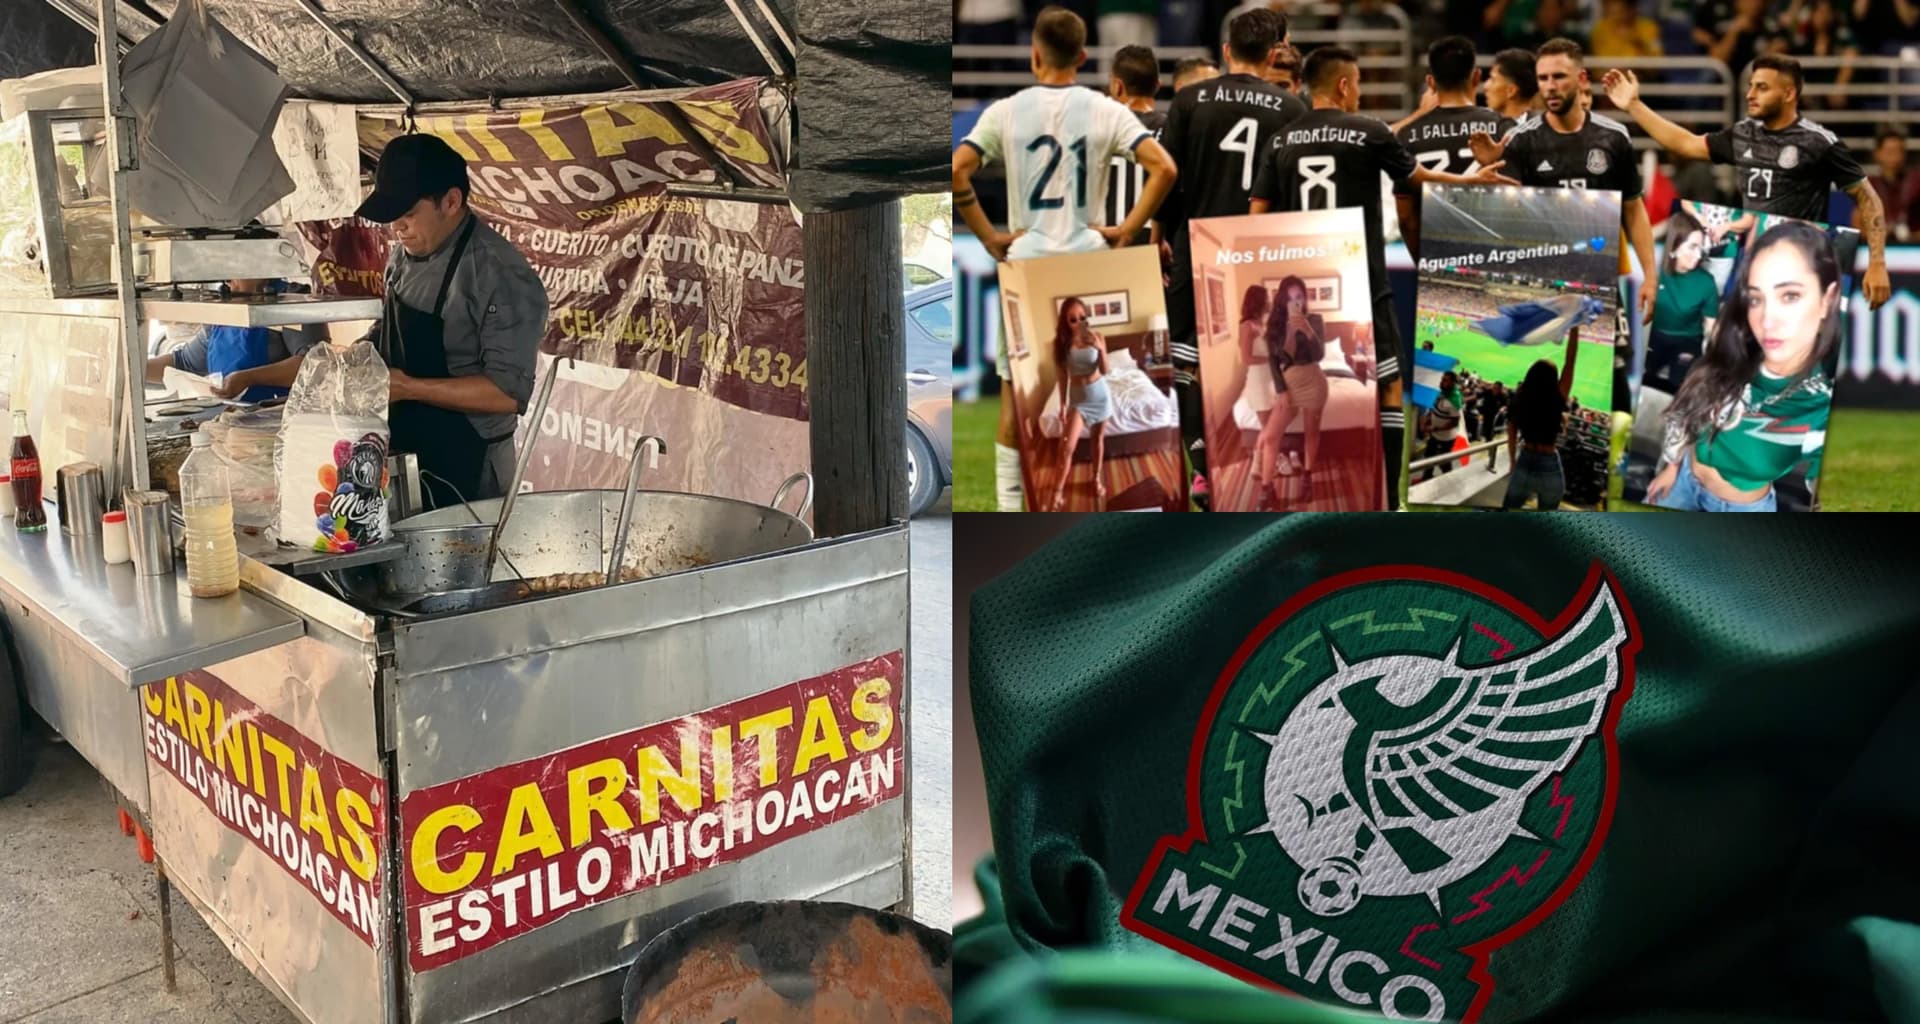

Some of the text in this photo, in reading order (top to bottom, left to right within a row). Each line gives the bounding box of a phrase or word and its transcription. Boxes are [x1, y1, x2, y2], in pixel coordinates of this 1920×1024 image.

[1214, 85, 1283, 111] ÁLVAREZ
[1286, 124, 1368, 147] RODRÍGUEZ
[1025, 134, 1088, 211] 21
[1219, 117, 1259, 191] 4
[1298, 155, 1337, 213] 8
[1747, 167, 1773, 199] 29
[144, 676, 378, 882] CARNITAS
[410, 676, 894, 894] CARNITAS
[146, 712, 382, 950] ESTILO MICHOACAN
[418, 747, 896, 957] ESTILO MICHOACAN
[1152, 868, 1447, 1022] MEXICO
